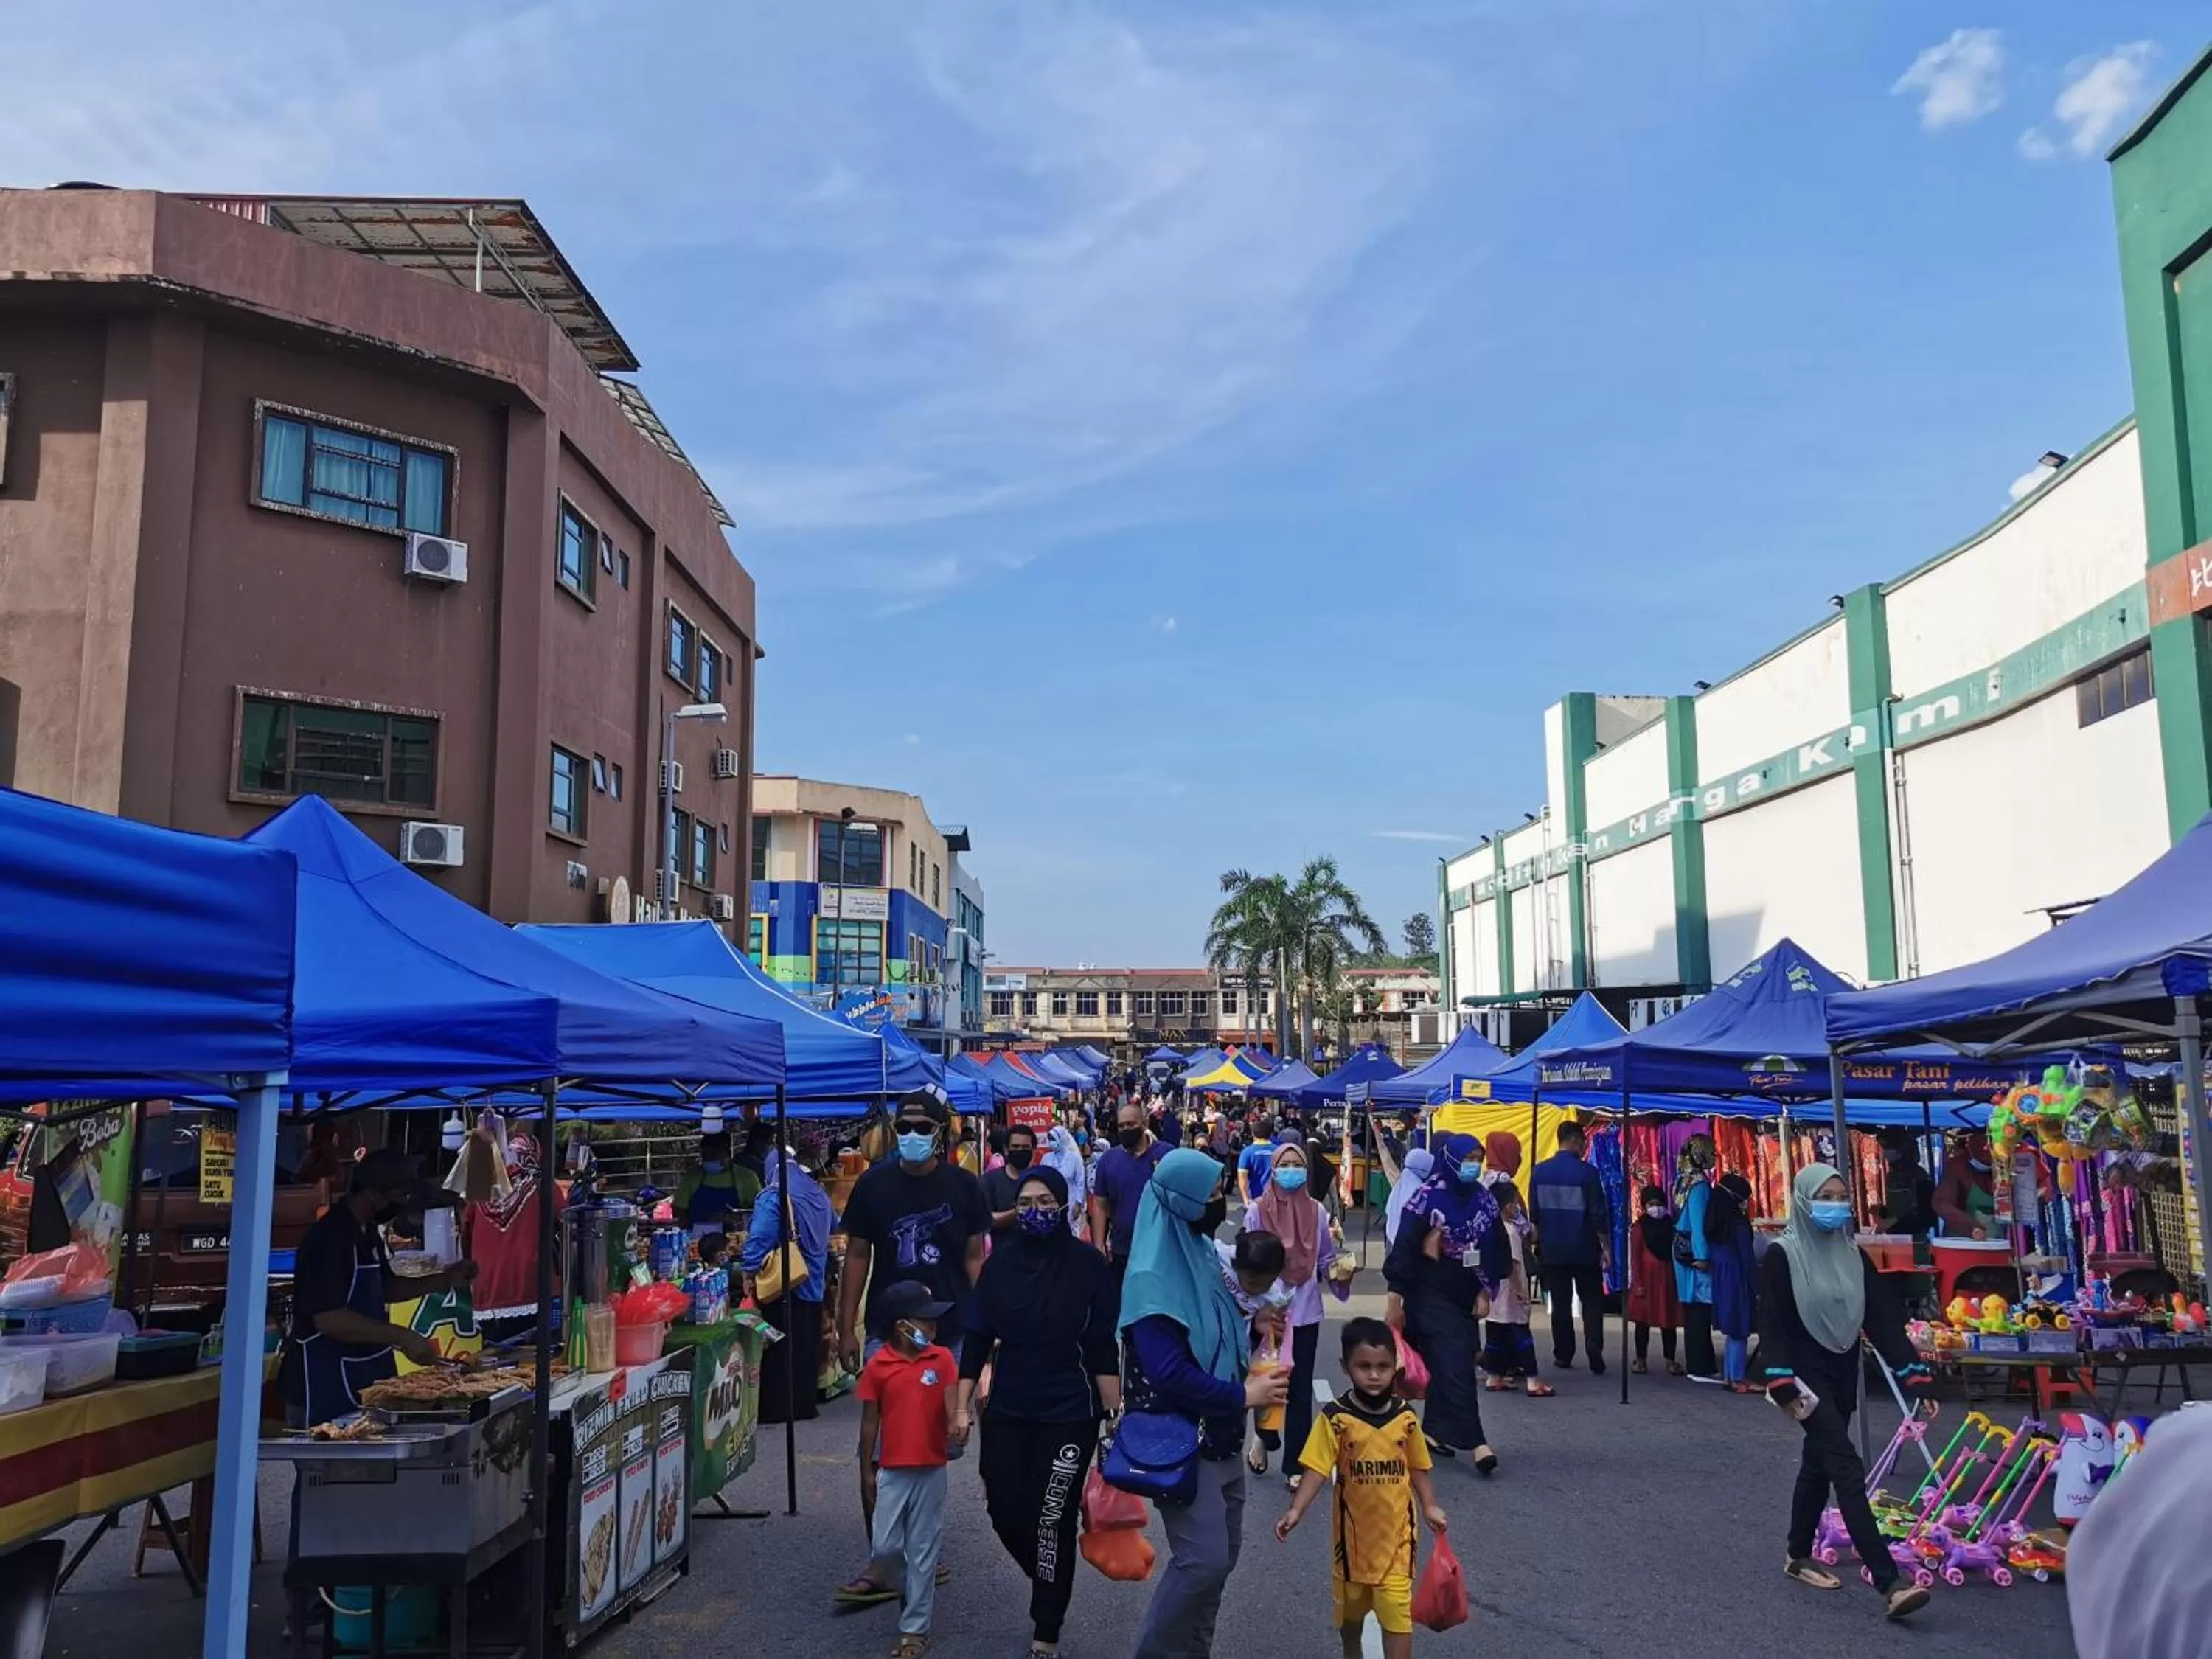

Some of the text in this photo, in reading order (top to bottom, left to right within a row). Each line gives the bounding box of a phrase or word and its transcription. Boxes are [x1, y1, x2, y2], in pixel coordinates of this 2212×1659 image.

[1628, 769, 1761, 839] Harga
[1798, 667, 2001, 773] Kami
[1842, 1060, 1951, 1079] Pasar Tani
[1902, 1079, 1948, 1092] pasar
[1954, 1076, 2010, 1092] pilihan
[1012, 1102, 1049, 1117] Popia
[79, 1118, 121, 1152] Boba
[192, 1237, 215, 1248] WGD
[651, 1373, 691, 1397] CHICKEN
[707, 1374, 742, 1423] MILO
[1349, 1459, 1405, 1476] HARIMAU
[1037, 1472, 1074, 1583] CONVERSE
